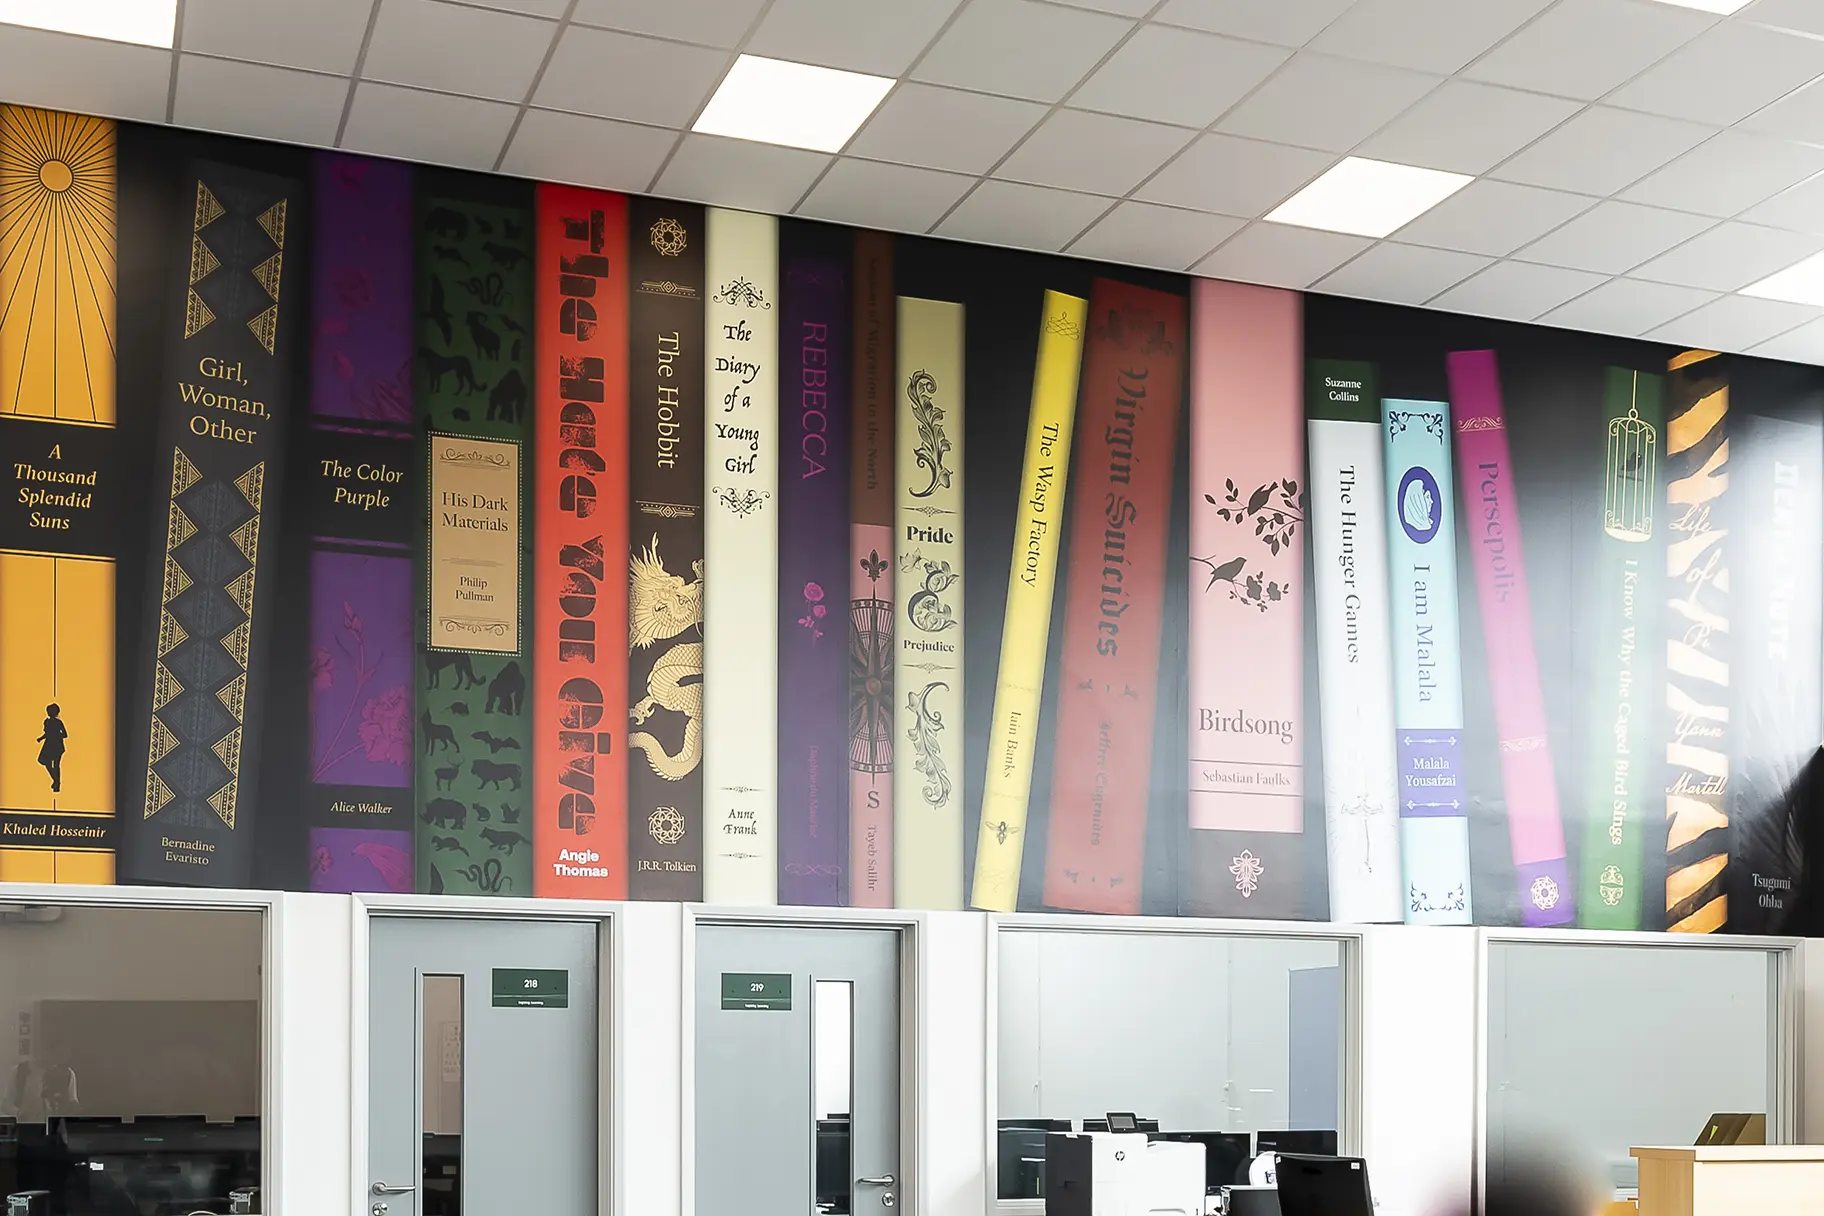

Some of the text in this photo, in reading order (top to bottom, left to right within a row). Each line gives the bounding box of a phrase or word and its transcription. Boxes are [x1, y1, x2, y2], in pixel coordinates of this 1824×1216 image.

[559, 209, 609, 342] The
[723, 320, 752, 341] The
[199, 357, 248, 386] Girl,
[715, 356, 760, 384] Diary
[1325, 376, 1362, 389] Suzanne
[178, 382, 271, 420] Woman,
[657, 331, 680, 469] The Hobbit
[724, 386, 751, 412] of a
[802, 321, 827, 479] REBECCA
[1328, 390, 1360, 402] Collins
[190, 415, 257, 444] Other
[559, 355, 607, 519] Hate
[715, 423, 759, 451] Young
[48, 444, 62, 460] A
[14, 463, 97, 486] Thousand
[320, 460, 403, 483] The Color
[725, 454, 758, 474] Girl
[18, 487, 92, 509] Splendid
[334, 487, 390, 511] Purple
[442, 491, 509, 512] His Dark
[1021, 423, 1060, 588] The Wasp Factory
[29, 512, 70, 530] Suns
[442, 513, 509, 532] Materials
[1096, 366, 1149, 657] Virgin Suicides
[1667, 505, 1712, 541] Life
[907, 525, 954, 544] Pride
[1477, 461, 1516, 604] Persepolis
[1338, 465, 1362, 664] The Hunger Games
[1685, 547, 1722, 601] of
[459, 576, 488, 589] Philip
[455, 589, 494, 602] Pullman
[1623, 570, 1638, 620] Know
[1413, 564, 1438, 703] I am Malala
[1616, 625, 1636, 665] Why
[903, 639, 955, 653] Prejudice
[1618, 670, 1634, 698] the
[1198, 707, 1294, 745] Birdsong
[1613, 702, 1632, 755] Caged
[1675, 711, 1725, 744] Yann
[558, 677, 611, 836] Give
[1003, 711, 1022, 779] Iain Banks
[1413, 757, 1450, 769] Malala
[1202, 769, 1253, 784] Sebastian
[1405, 774, 1457, 787] Yousafzai
[1613, 758, 1629, 796] Bird
[1665, 771, 1728, 796] Martell
[330, 800, 393, 815] Alice Walker
[728, 808, 755, 820] Anne
[3, 823, 107, 838] Khaled Hosseinir
[722, 820, 757, 836] Frank
[1608, 799, 1627, 846] Sings
[160, 836, 215, 852] Bernadine
[865, 825, 880, 857] Tayeb
[165, 851, 210, 866] Evaristo
[559, 848, 600, 863] Angie
[637, 860, 697, 873] J.R.R. Tolkien
[553, 863, 609, 878] Thomas
[1752, 873, 1792, 892] Tsugumi
[1758, 894, 1783, 908] Ohba
[523, 979, 538, 988] 218
[750, 982, 765, 992] 219
